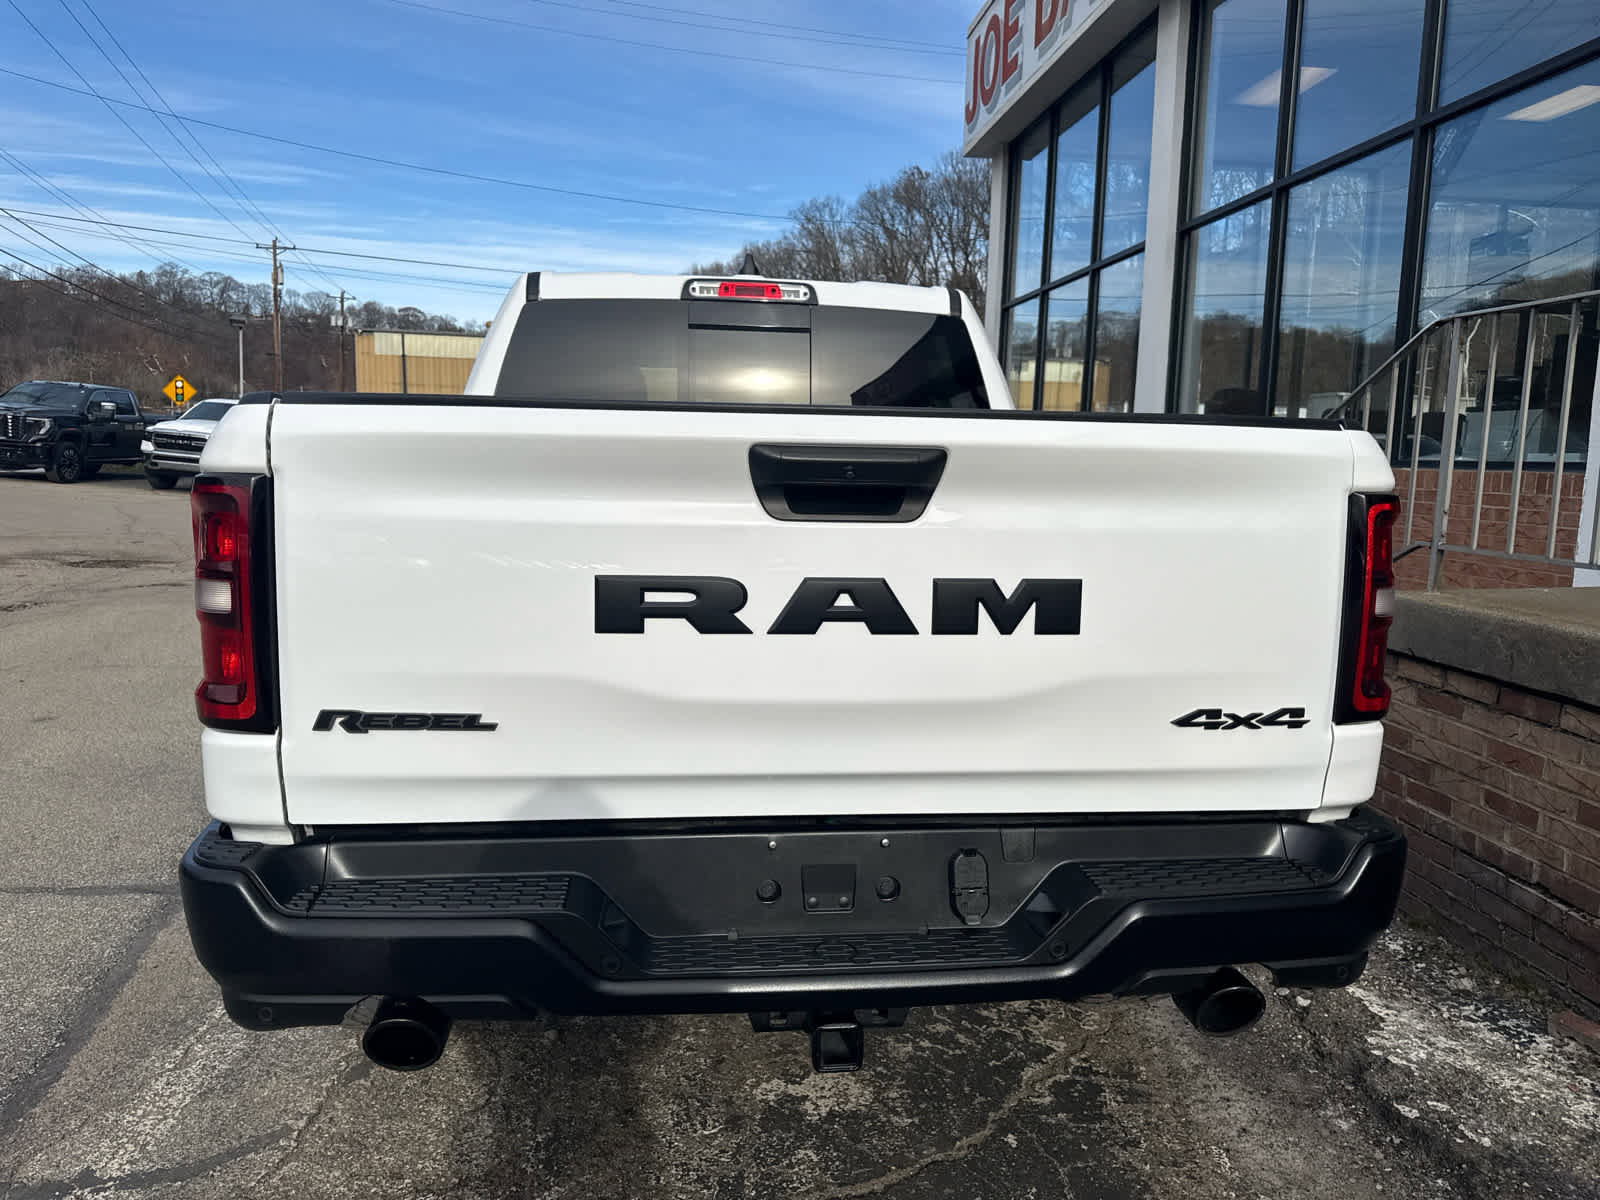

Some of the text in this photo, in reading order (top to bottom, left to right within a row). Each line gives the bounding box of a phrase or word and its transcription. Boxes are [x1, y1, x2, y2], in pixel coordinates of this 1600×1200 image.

[965, 0, 1020, 126] JOE
[594, 574, 1083, 635] RAM
[312, 709, 499, 734] REBEL
[1169, 707, 1311, 730] 4x4
